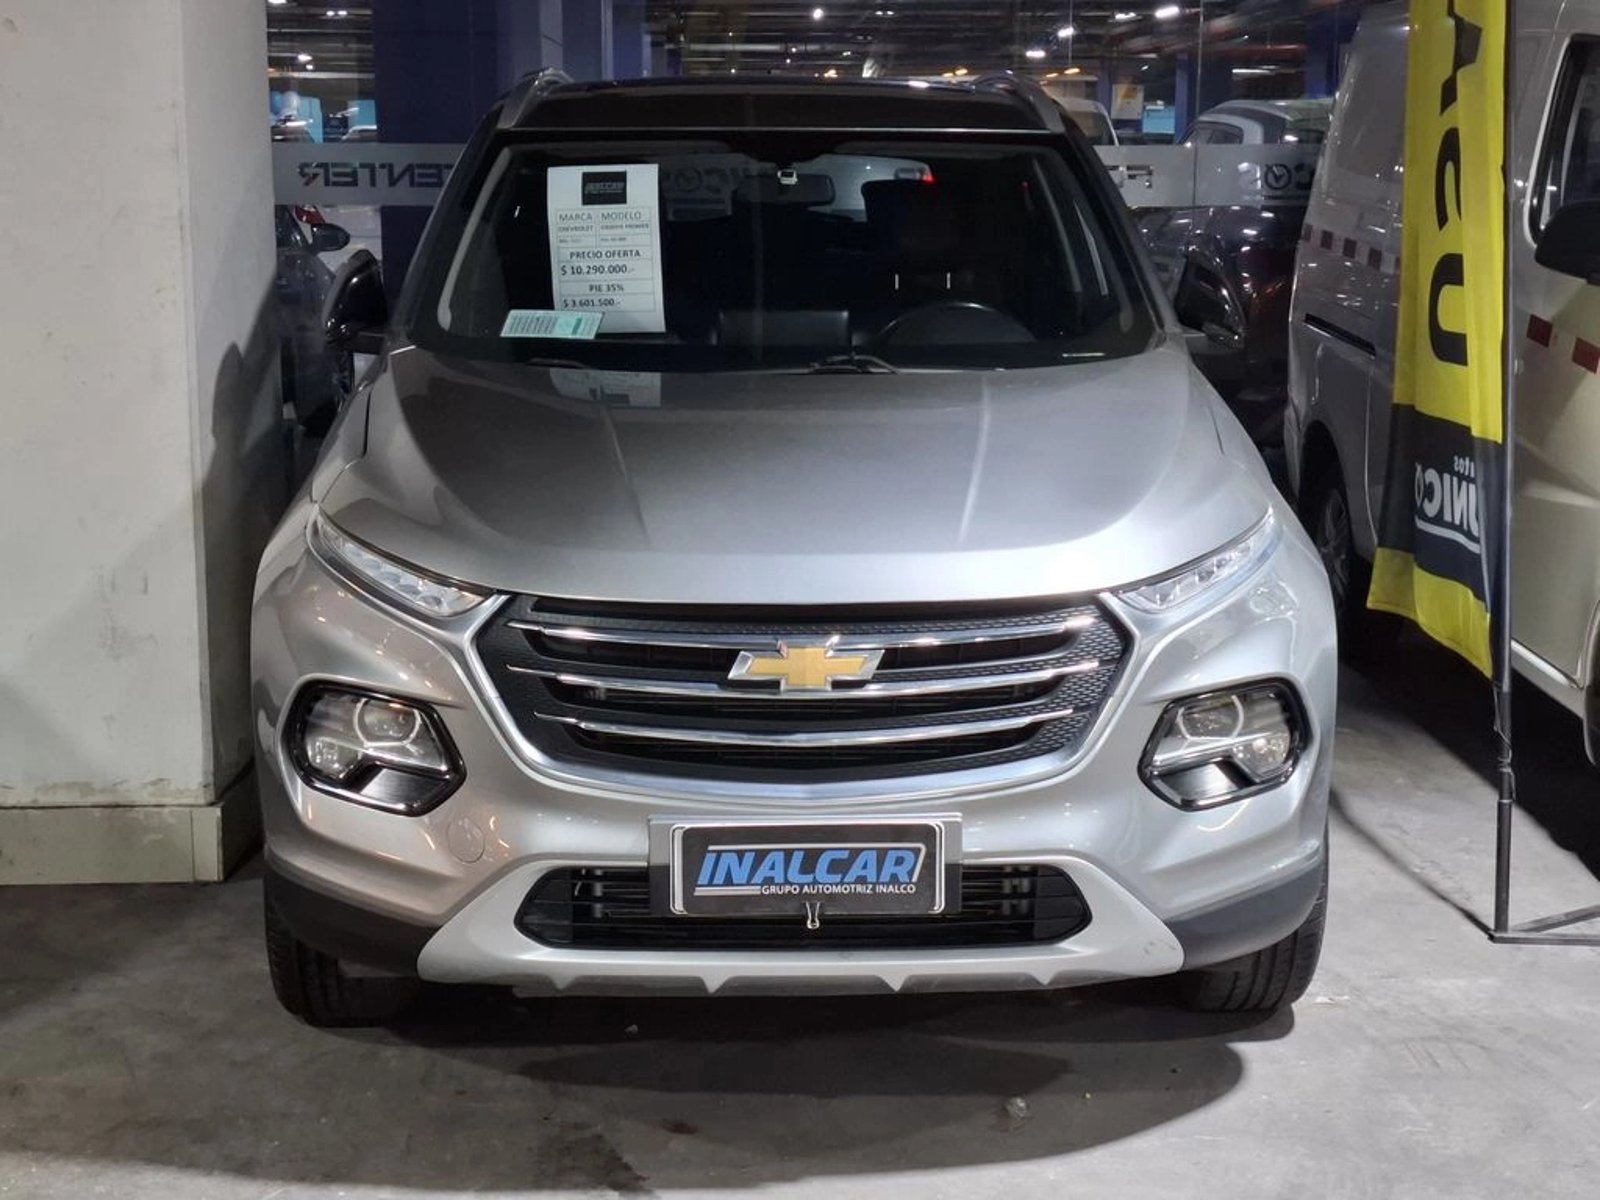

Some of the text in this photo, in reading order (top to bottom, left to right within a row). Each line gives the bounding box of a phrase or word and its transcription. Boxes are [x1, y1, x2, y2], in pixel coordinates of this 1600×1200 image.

[558, 212, 593, 221] MARCA
[601, 211, 642, 220] MODELO
[569, 249, 641, 259] PRECIO OFERTA
[561, 265, 567, 276] $
[589, 284, 624, 292] PIE 35%
[563, 299, 569, 308] $
[697, 850, 919, 886] INALCAR
[761, 883, 917, 895] GRUPO AUTOMOTRIZ INALCO
